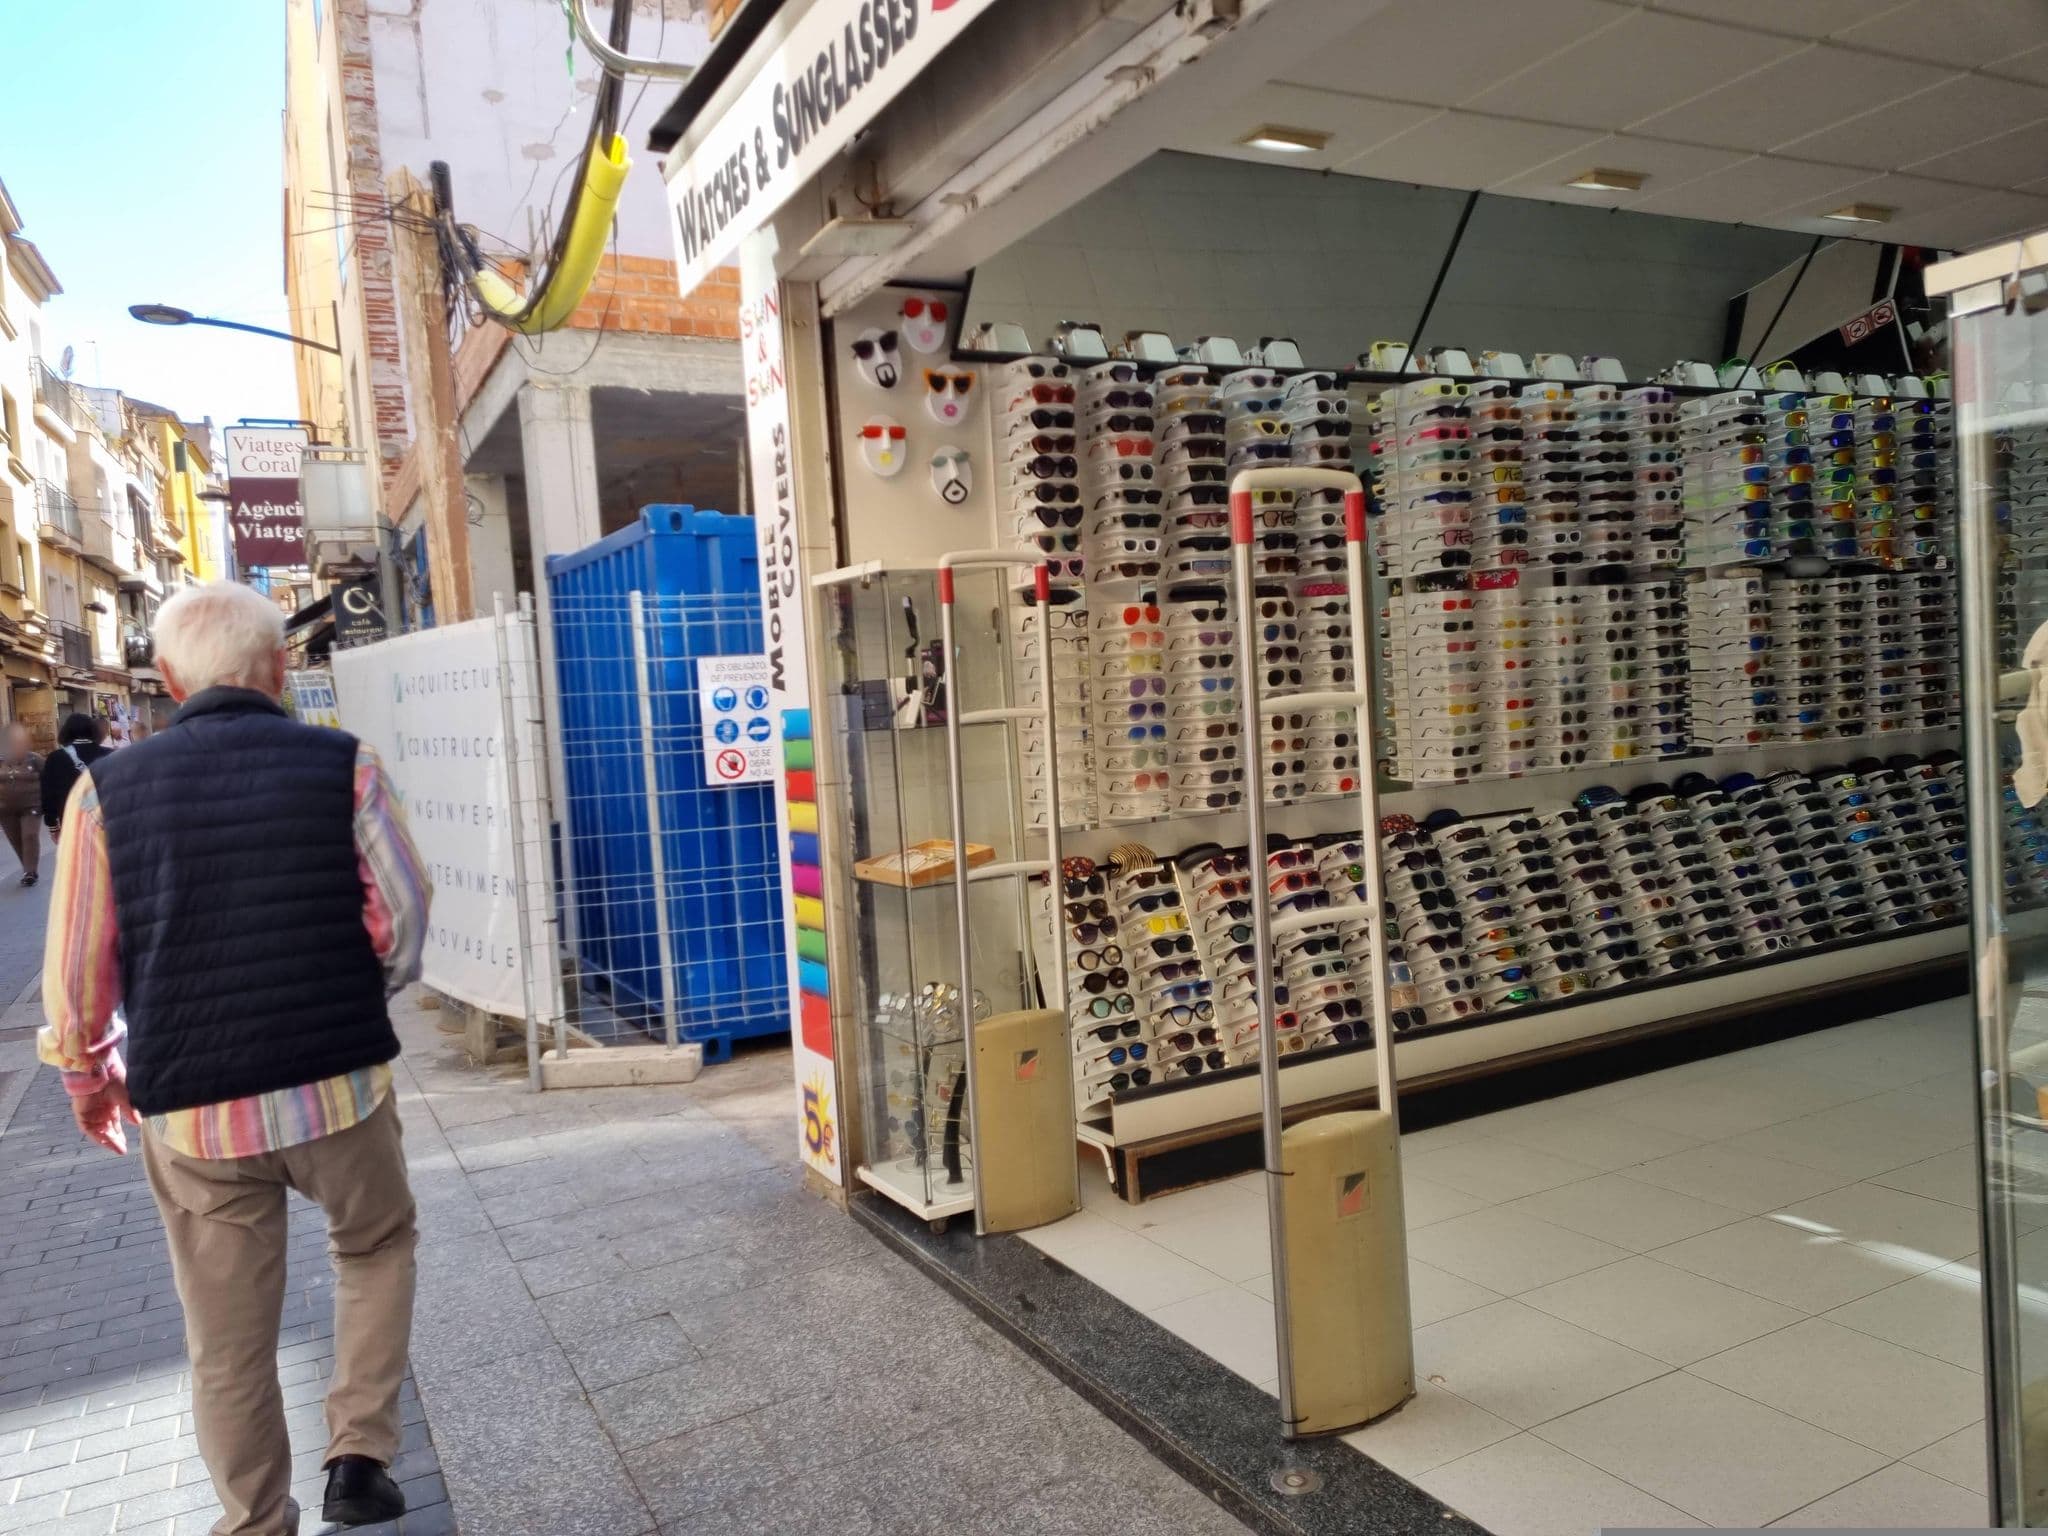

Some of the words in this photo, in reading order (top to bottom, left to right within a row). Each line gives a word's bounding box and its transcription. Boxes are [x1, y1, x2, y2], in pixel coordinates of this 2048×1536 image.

[677, 142, 750, 264] WATCHES
[755, 126, 771, 191] &
[773, 0, 919, 169] SUNGLASSES
[233, 436, 305, 456] Viatges
[241, 456, 297, 473] Coral
[237, 501, 305, 520] Agènci
[772, 422, 795, 598] COVERS
[238, 523, 305, 542] Viatge
[764, 524, 786, 691] MOBILE
[427, 926, 514, 968] NOVABLE
